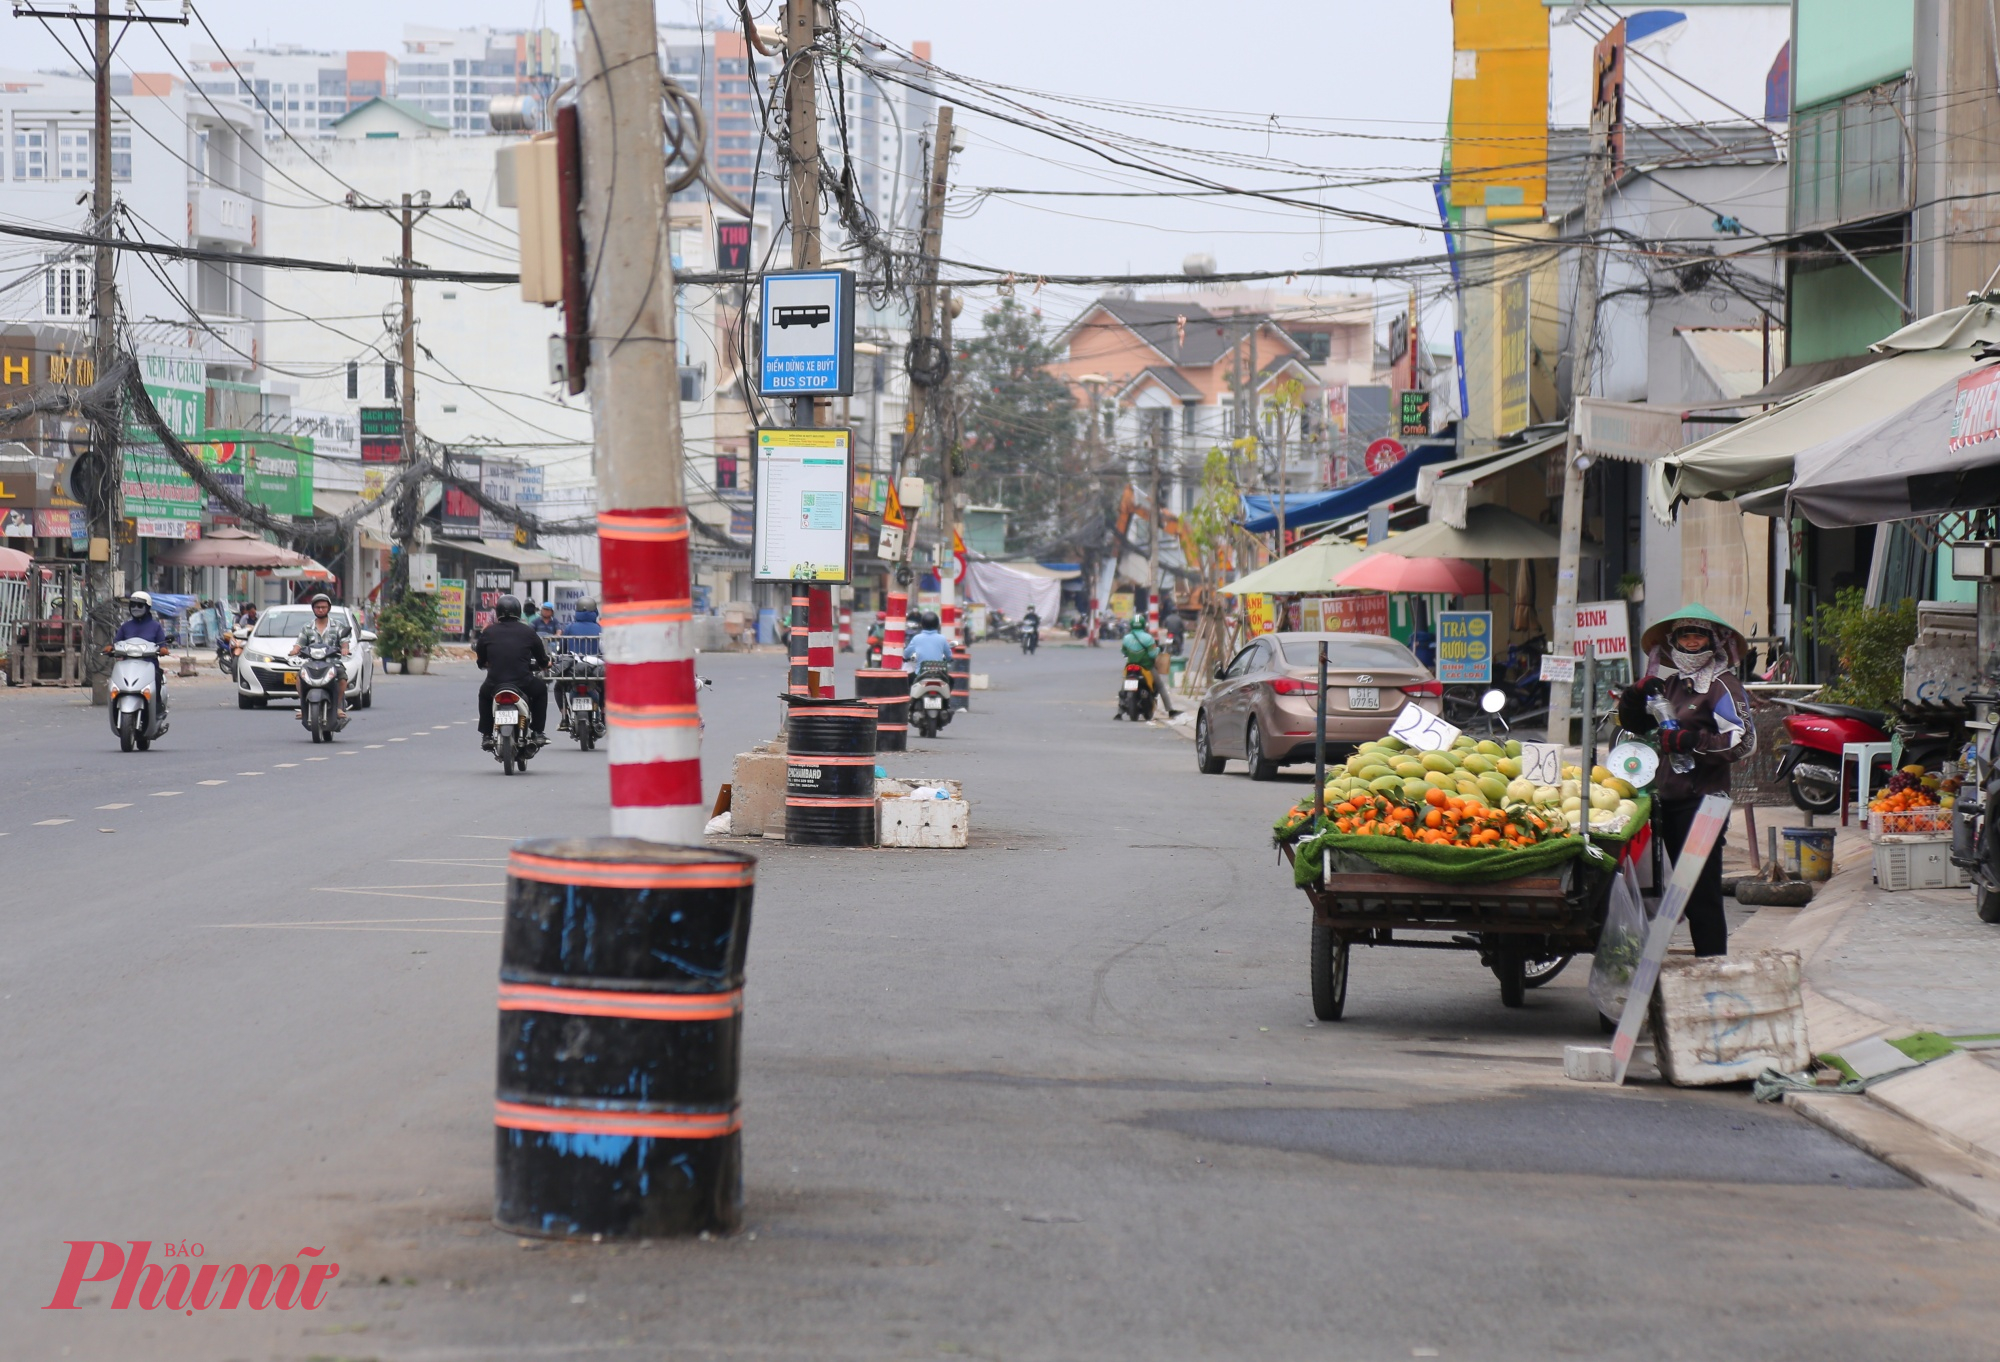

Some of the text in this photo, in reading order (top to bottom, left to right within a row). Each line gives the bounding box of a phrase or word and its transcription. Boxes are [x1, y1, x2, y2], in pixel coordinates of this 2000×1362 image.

[729, 247, 739, 266] Y
[766, 357, 835, 372] ĐIỂM DỪNG XE BUÝT
[773, 376, 828, 387] BUS STOP
[1324, 601, 1344, 614] MR
[1597, 636, 1627, 654] TINH
[1356, 688, 1372, 698] 51F
[1393, 704, 1446, 751] 25
[1523, 744, 1557, 785] 20
